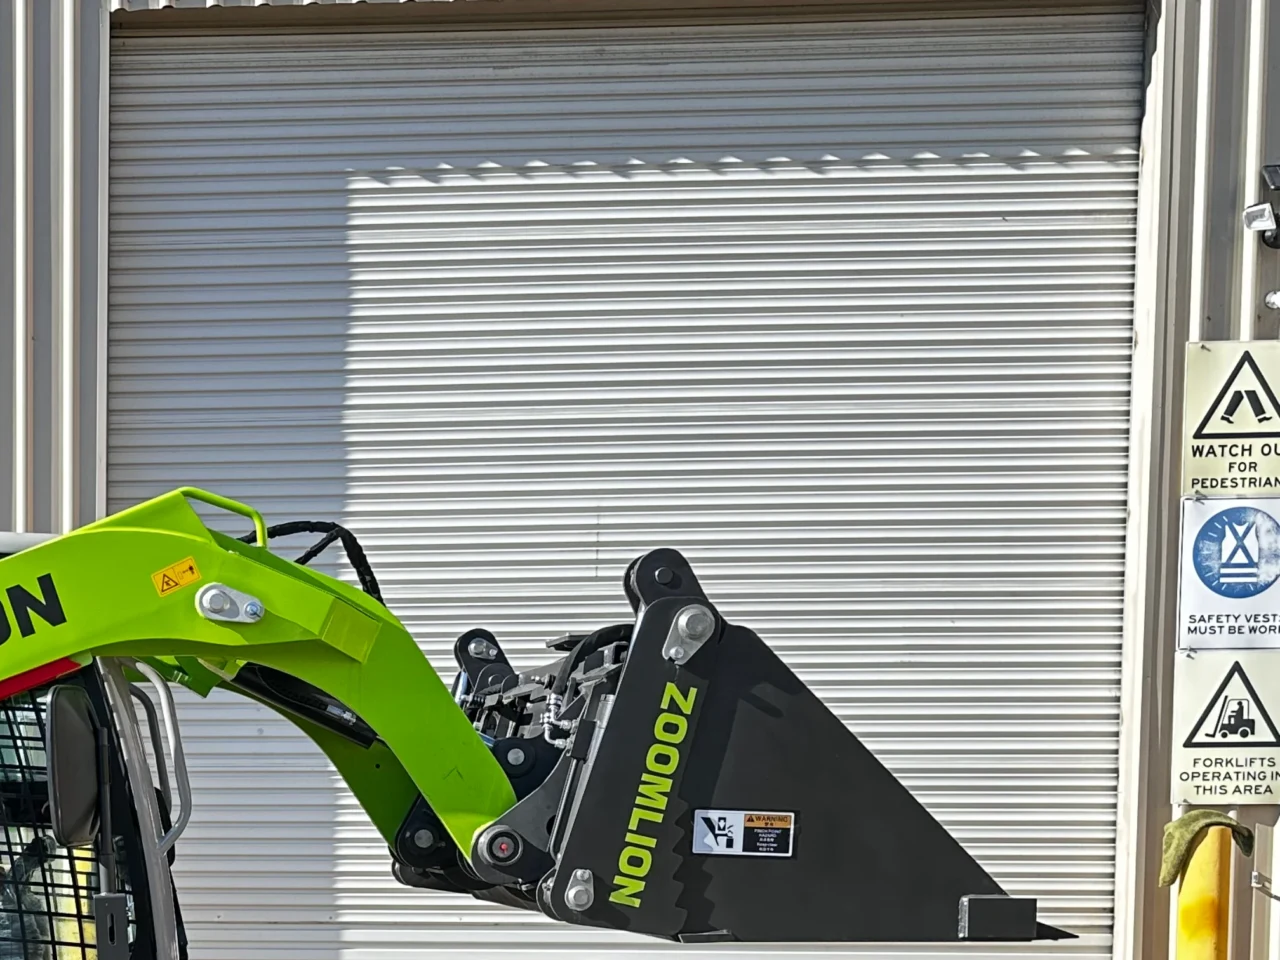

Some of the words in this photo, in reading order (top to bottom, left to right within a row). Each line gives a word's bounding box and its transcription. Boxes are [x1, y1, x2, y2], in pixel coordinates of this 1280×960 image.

[1191, 443, 1253, 458] WATCH
[1228, 461, 1258, 473] FOR
[1188, 613, 1241, 624] SAFETY
[1244, 613, 1280, 624] VEST
[1187, 625, 1225, 635] MUST
[1228, 625, 1245, 635] BE
[1248, 624, 1280, 635] WOR
[1192, 757, 1276, 768] FORKLIFTS
[1179, 770, 1267, 782] OPERATING
[609, 681, 698, 908] ZOOMLION
[1193, 785, 1228, 796] THIS
[1231, 784, 1273, 795] AREA
